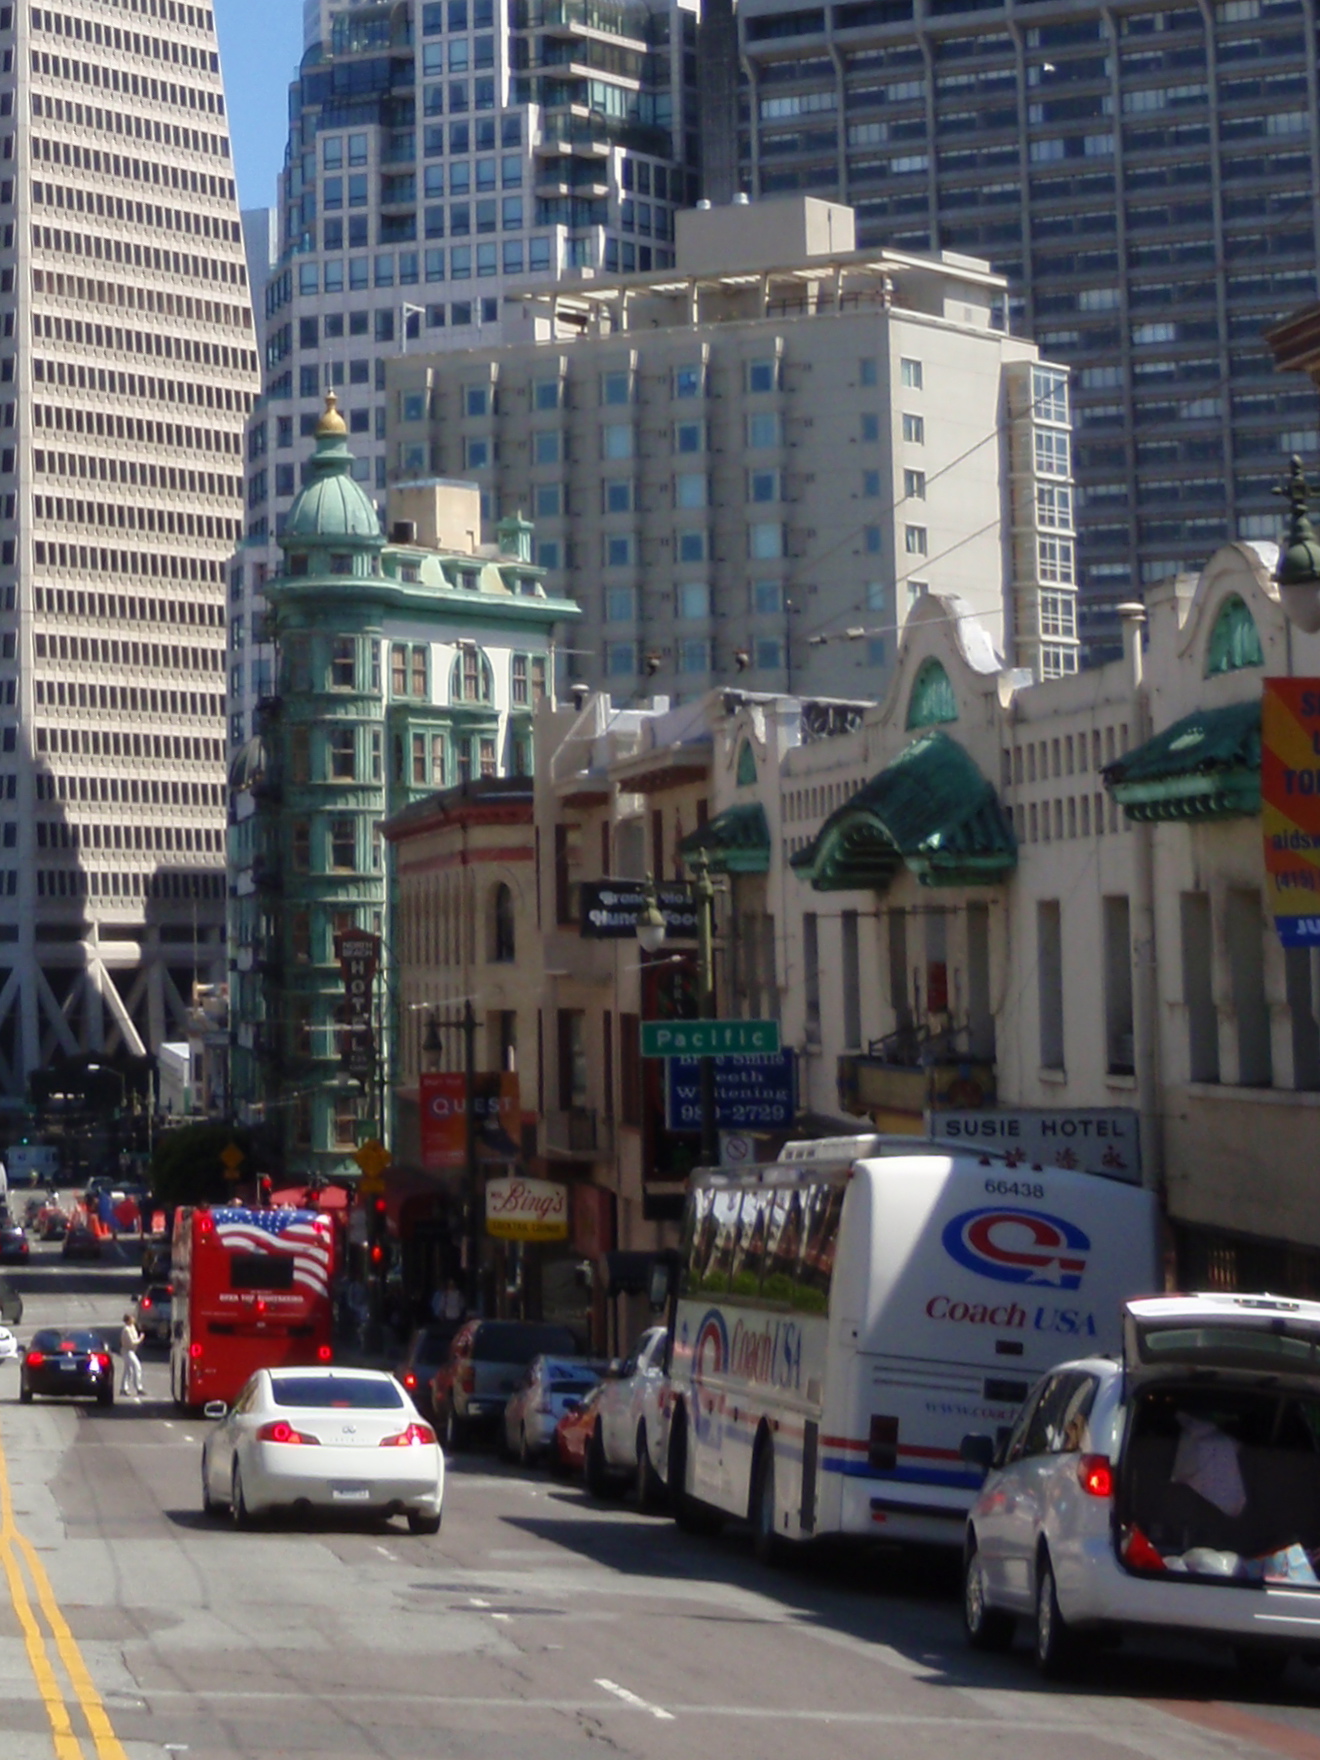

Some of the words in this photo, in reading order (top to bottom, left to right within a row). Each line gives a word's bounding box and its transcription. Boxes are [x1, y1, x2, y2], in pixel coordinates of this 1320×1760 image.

[656, 1028, 764, 1047] Pacific
[713, 1070, 764, 1083] eeth
[676, 1086, 787, 1101] Witening
[432, 1096, 512, 1116] QUEST
[945, 1119, 1020, 1137] SUSIE
[1041, 1119, 1125, 1138] HOTEL
[984, 1179, 1045, 1199] 66438
[493, 1181, 564, 1220] Bing's
[926, 1295, 1027, 1328] Coach
[1033, 1306, 1096, 1337] USA
[731, 1317, 772, 1384] Coach
[771, 1319, 802, 1389] USA
